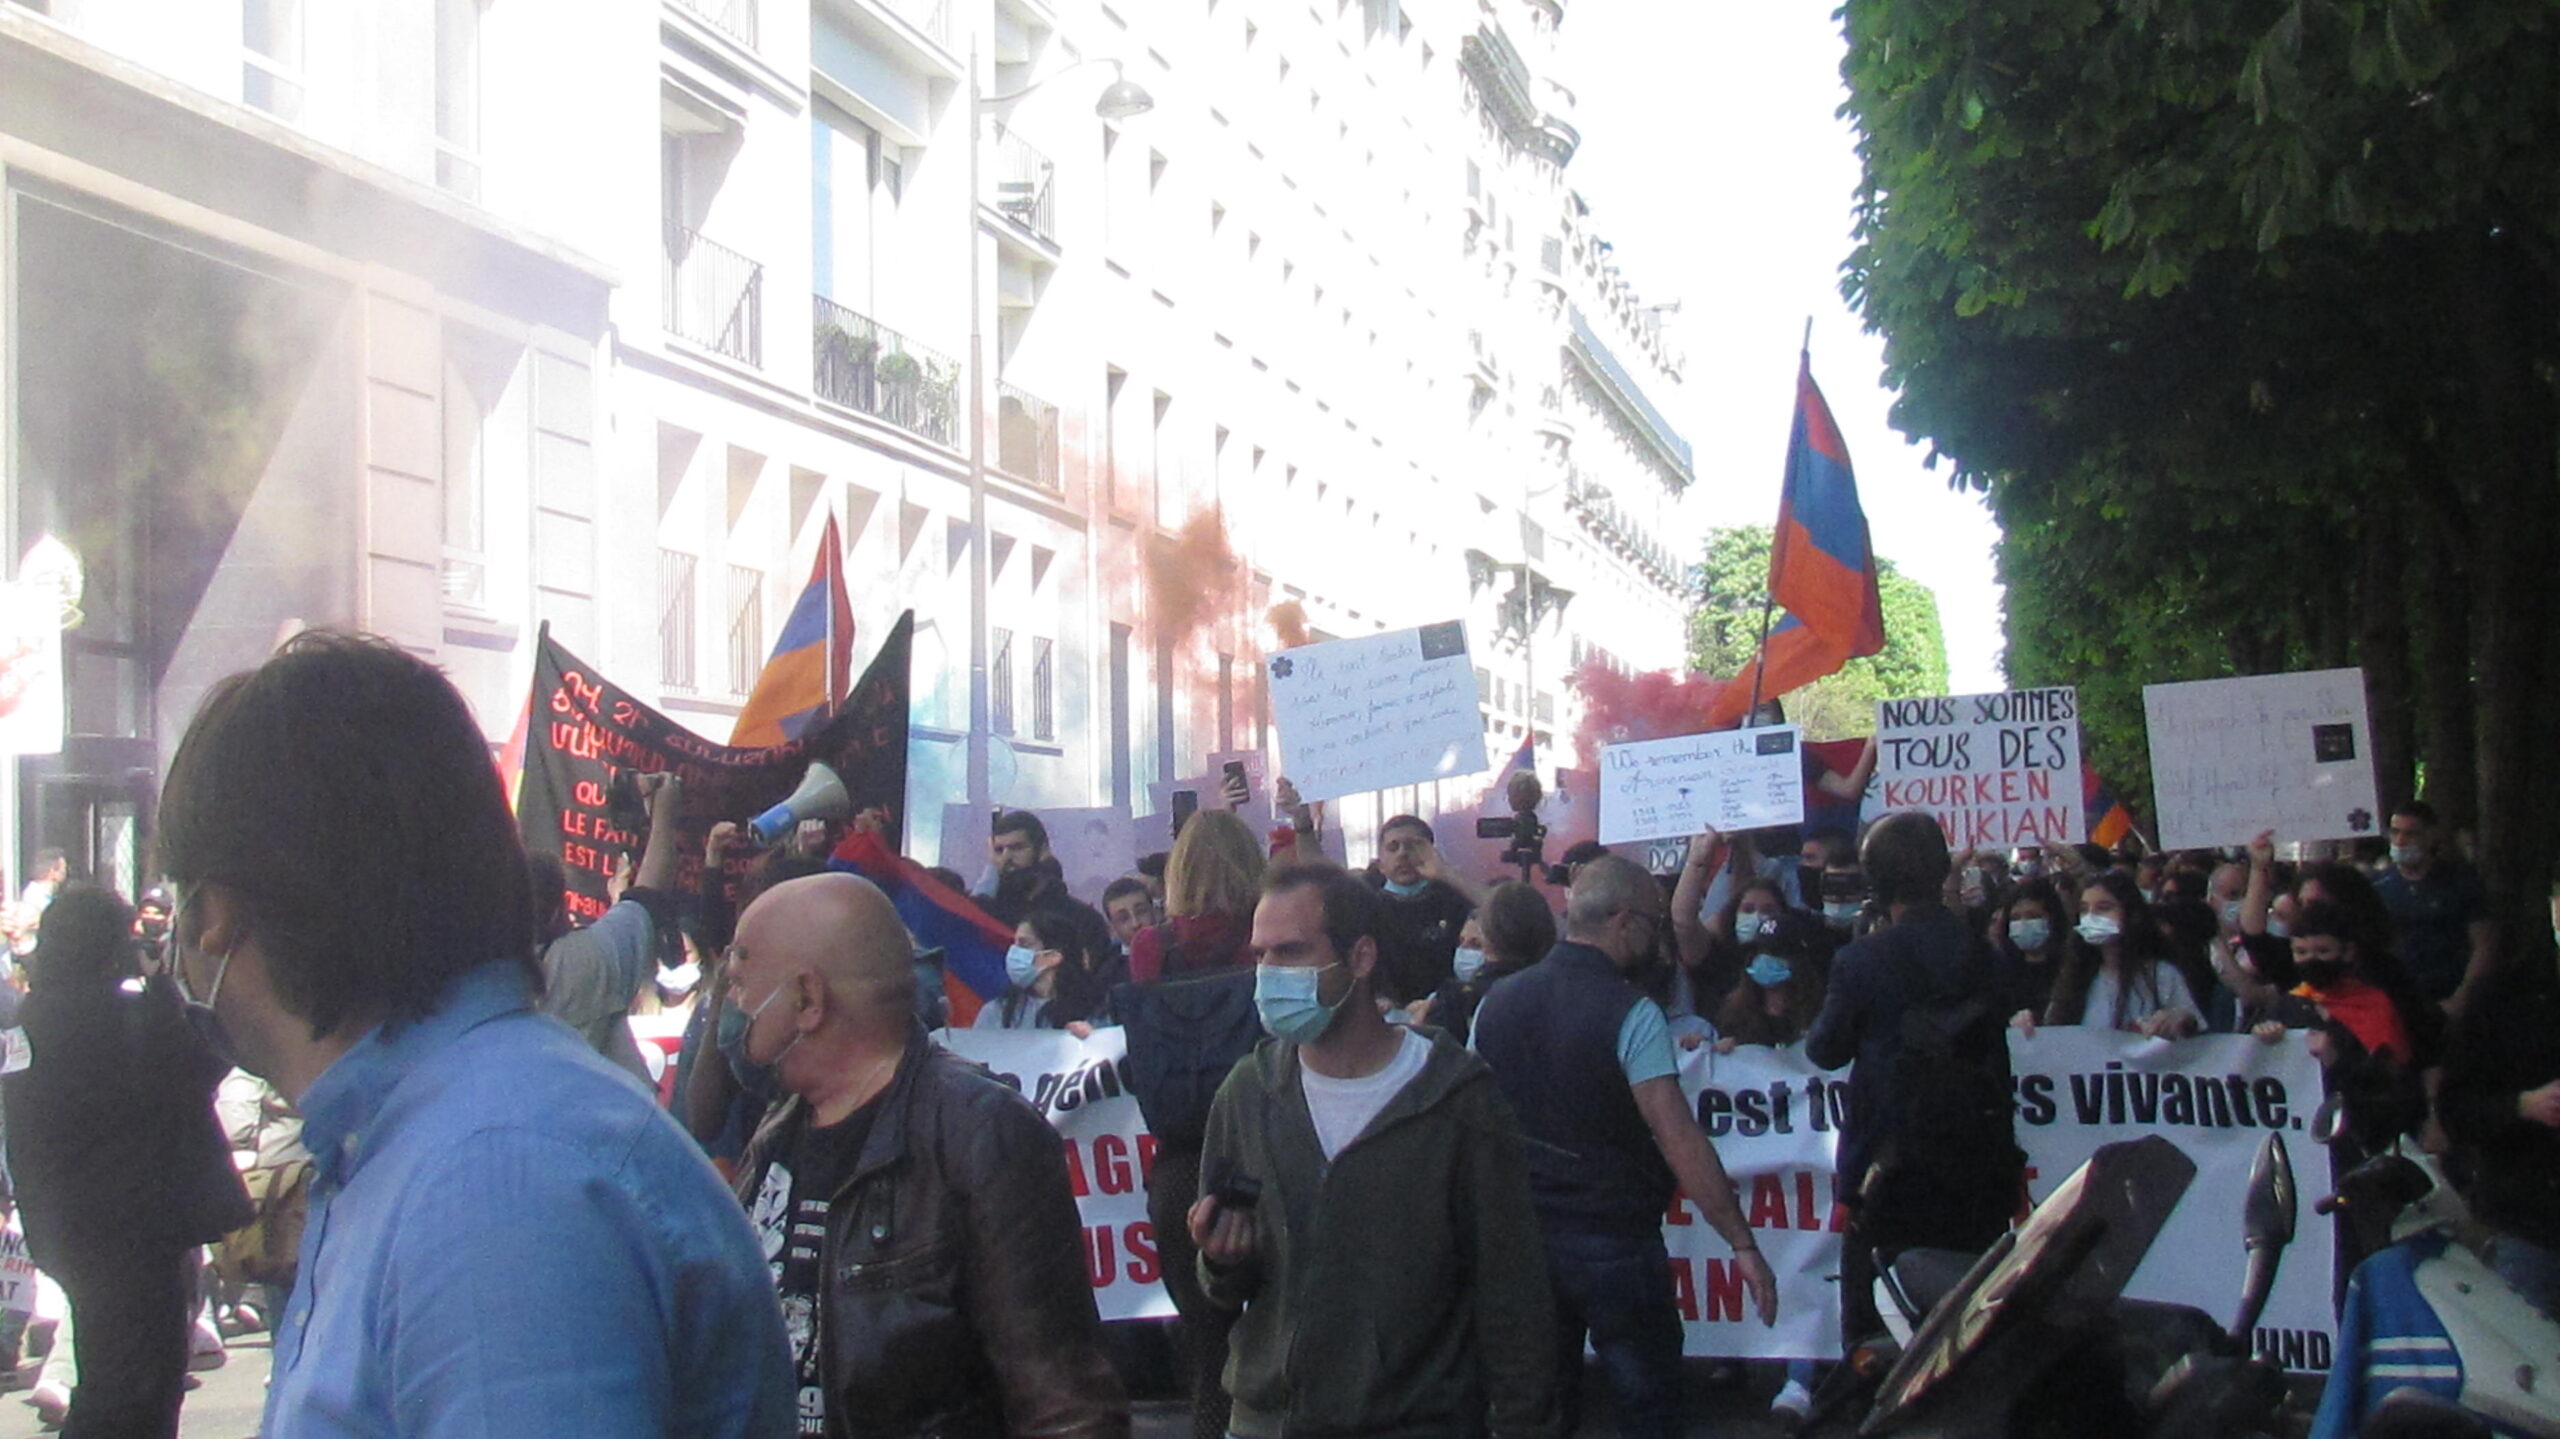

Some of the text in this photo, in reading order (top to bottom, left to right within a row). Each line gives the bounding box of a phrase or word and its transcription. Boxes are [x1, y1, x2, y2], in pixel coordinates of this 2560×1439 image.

[1883, 689, 2074, 729] NOUS SOMMES
[1882, 725, 2067, 771] TOUS DES
[1884, 770, 2050, 808] KOURKEN
[563, 809, 587, 836] LE
[565, 842, 597, 870] EST
[1697, 1081, 1793, 1137] est
[2069, 1061, 2302, 1131] vivante.
